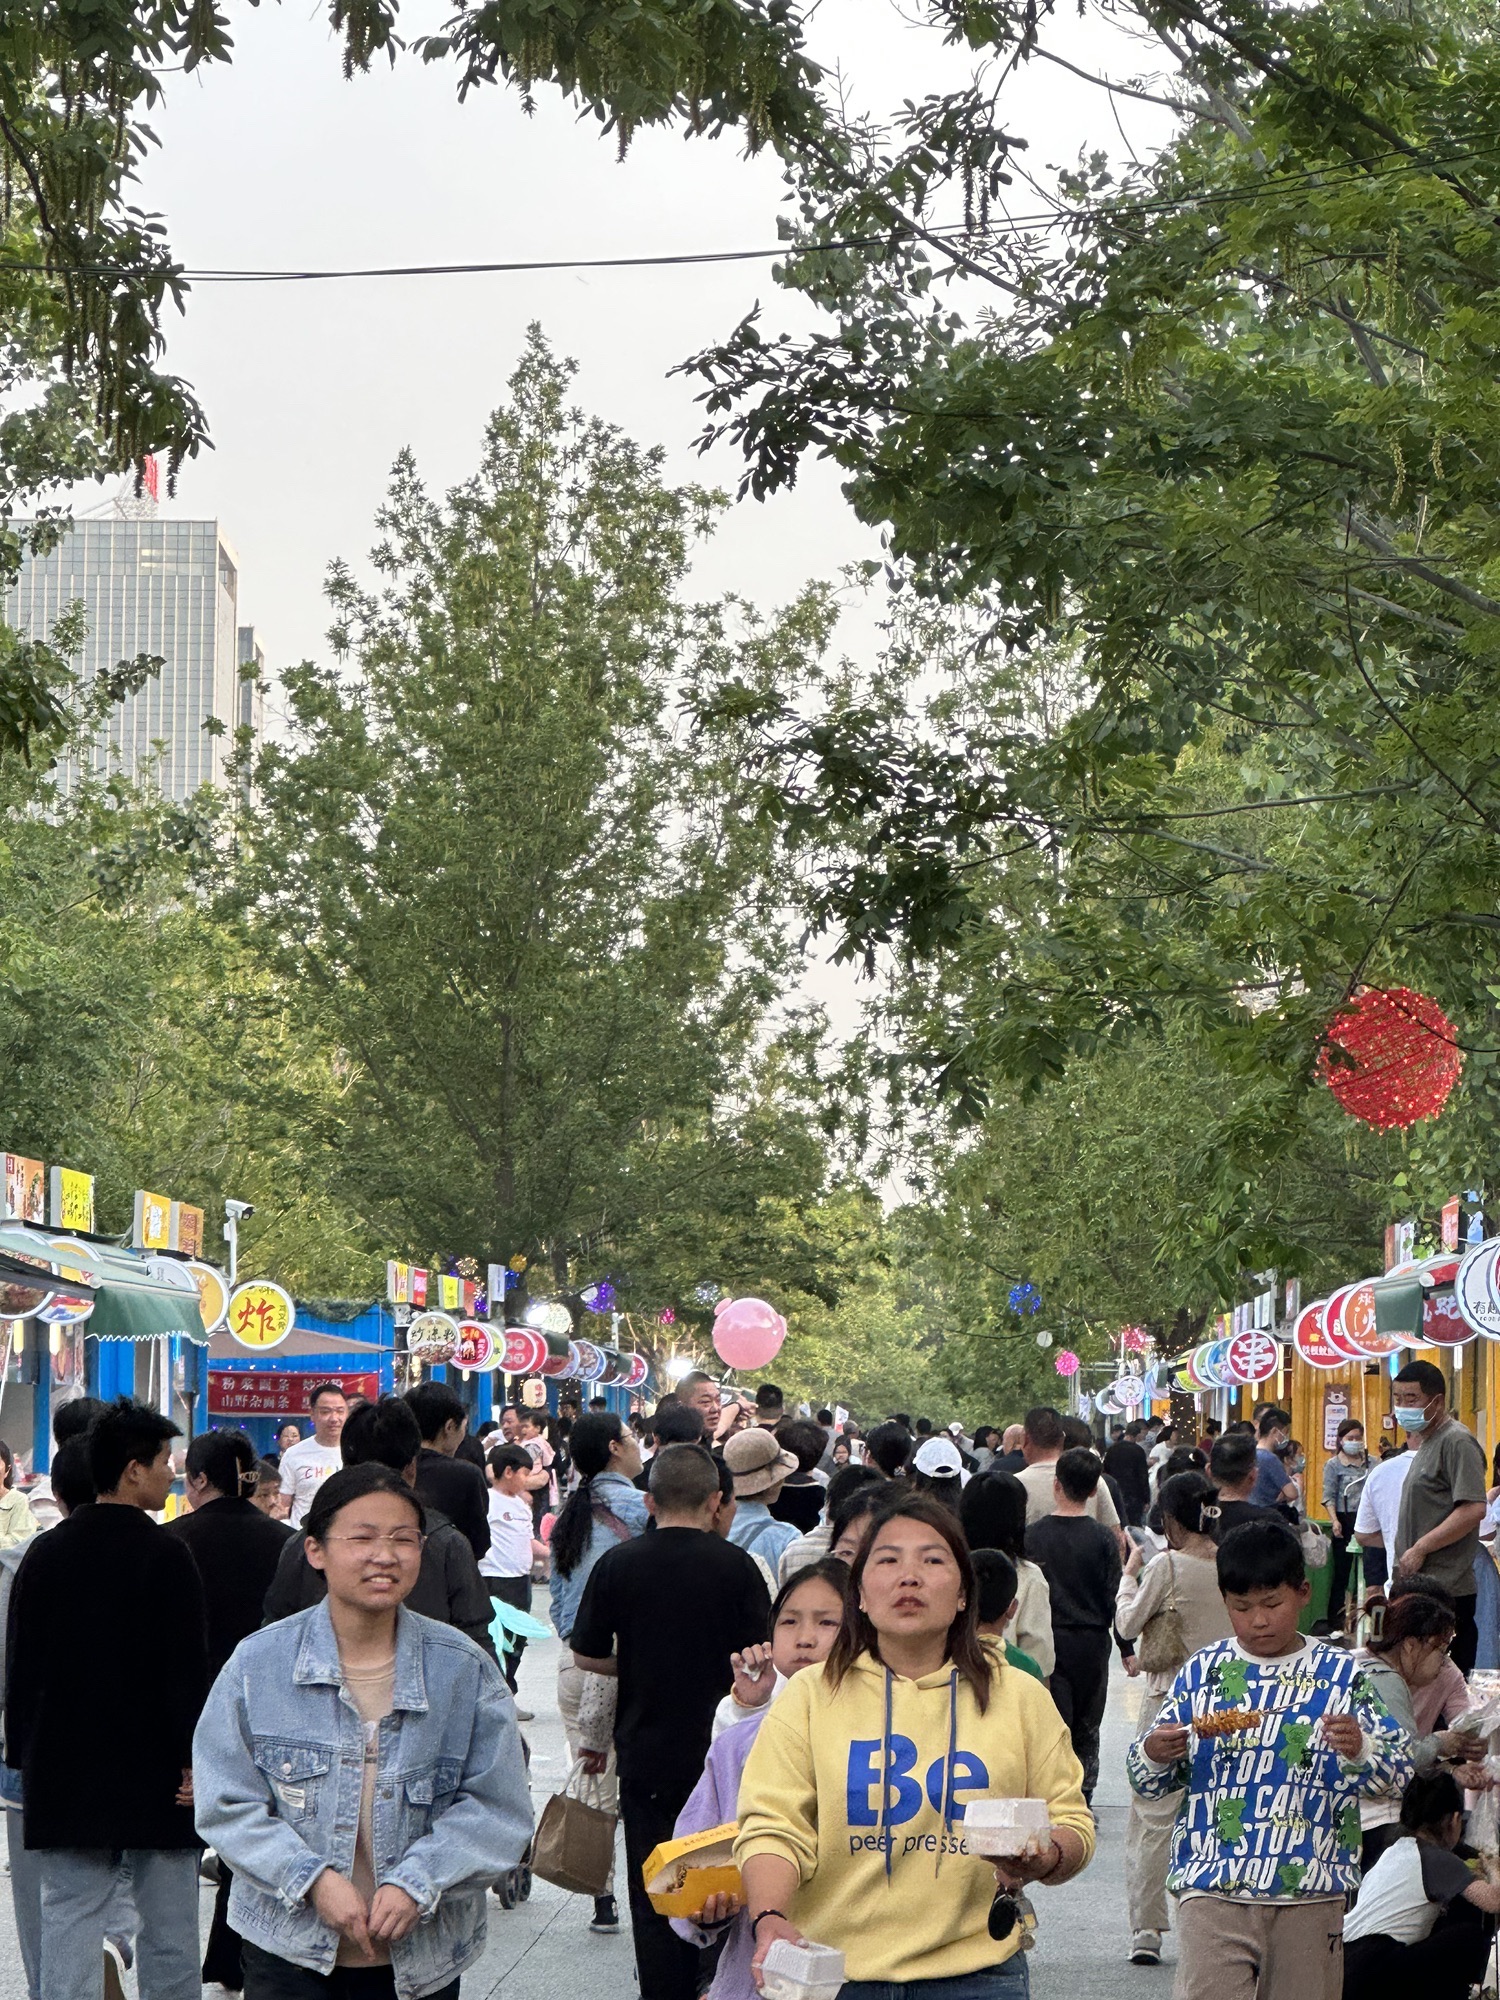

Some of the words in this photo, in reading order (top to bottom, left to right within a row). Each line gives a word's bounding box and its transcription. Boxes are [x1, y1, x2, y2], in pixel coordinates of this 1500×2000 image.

[236, 1297, 276, 1341] 炸
[1232, 1332, 1275, 1380] 串
[847, 1734, 989, 1827] Be
